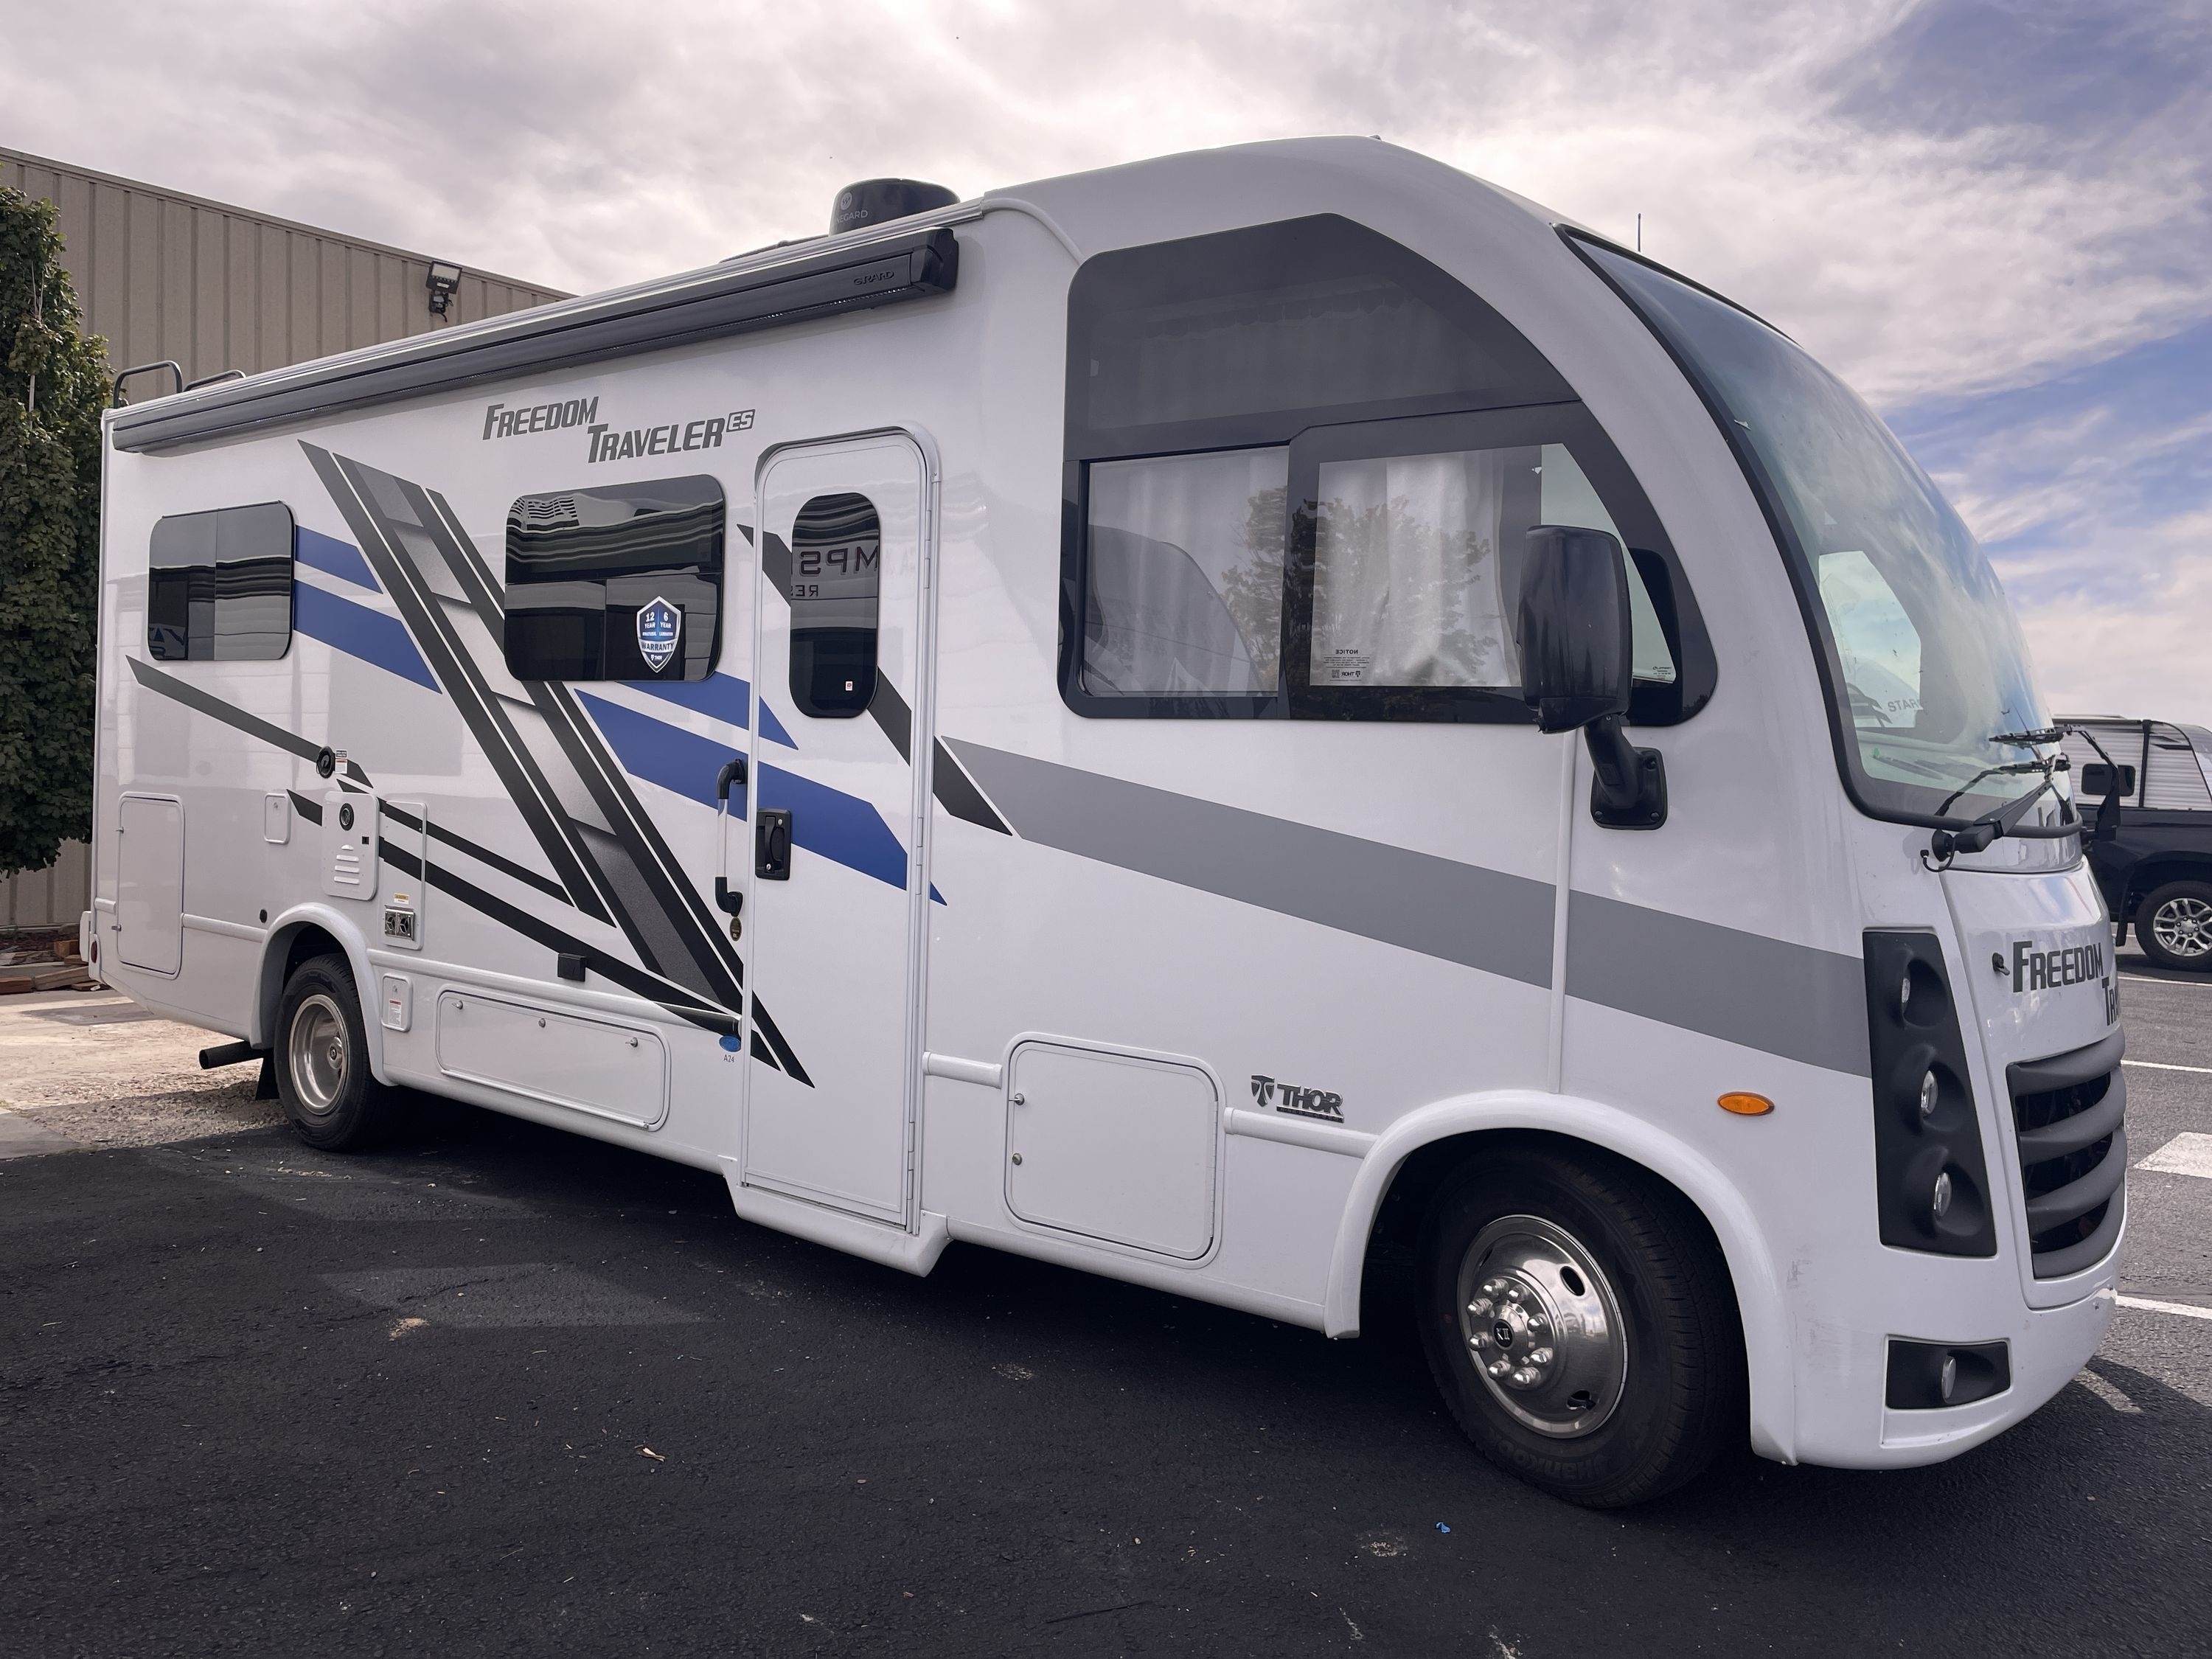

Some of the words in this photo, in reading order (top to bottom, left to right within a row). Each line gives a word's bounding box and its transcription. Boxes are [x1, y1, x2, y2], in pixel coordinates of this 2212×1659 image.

[482, 396, 599, 440] FREEDOM
[587, 418, 726, 463] TRAVELER
[727, 409, 755, 432] ES
[645, 611, 655, 622] 12
[663, 611, 669, 622] 6
[641, 641, 674, 650] WARRANTY
[2012, 940, 2104, 993] FREEDOM
[723, 1054, 735, 1062] A24
[1276, 1082, 1344, 1116] THOR
